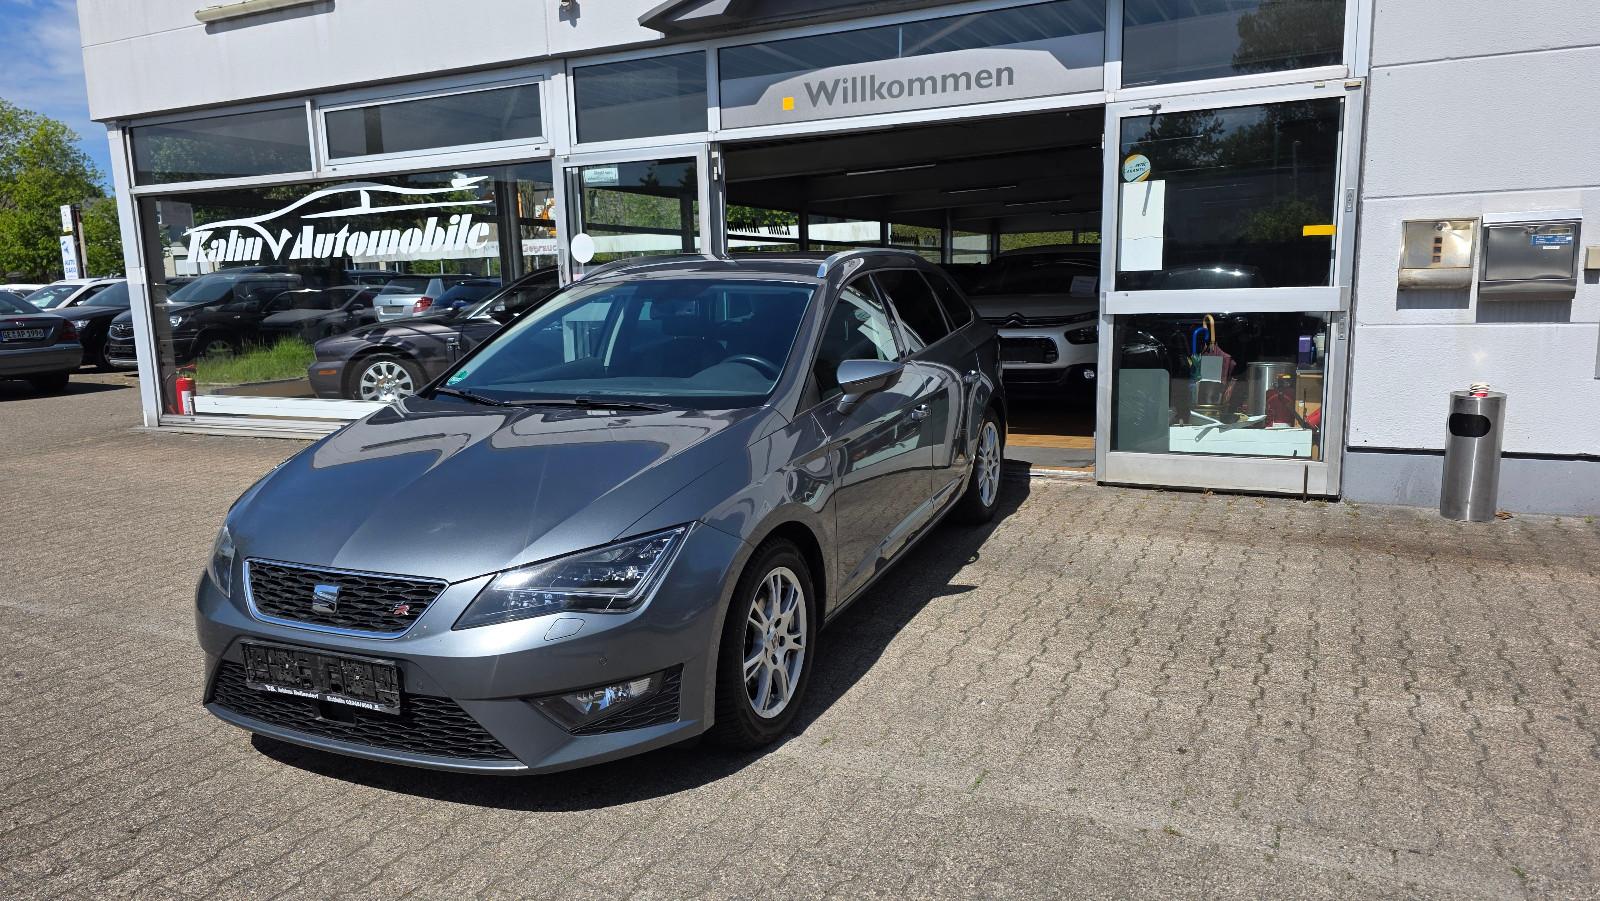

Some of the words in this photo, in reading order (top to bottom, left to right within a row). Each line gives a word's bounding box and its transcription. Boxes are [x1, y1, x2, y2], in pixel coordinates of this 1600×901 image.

[804, 66, 1014, 108] Willkommen
[186, 229, 263, 263] Kahn
[289, 213, 490, 261] Automobile
